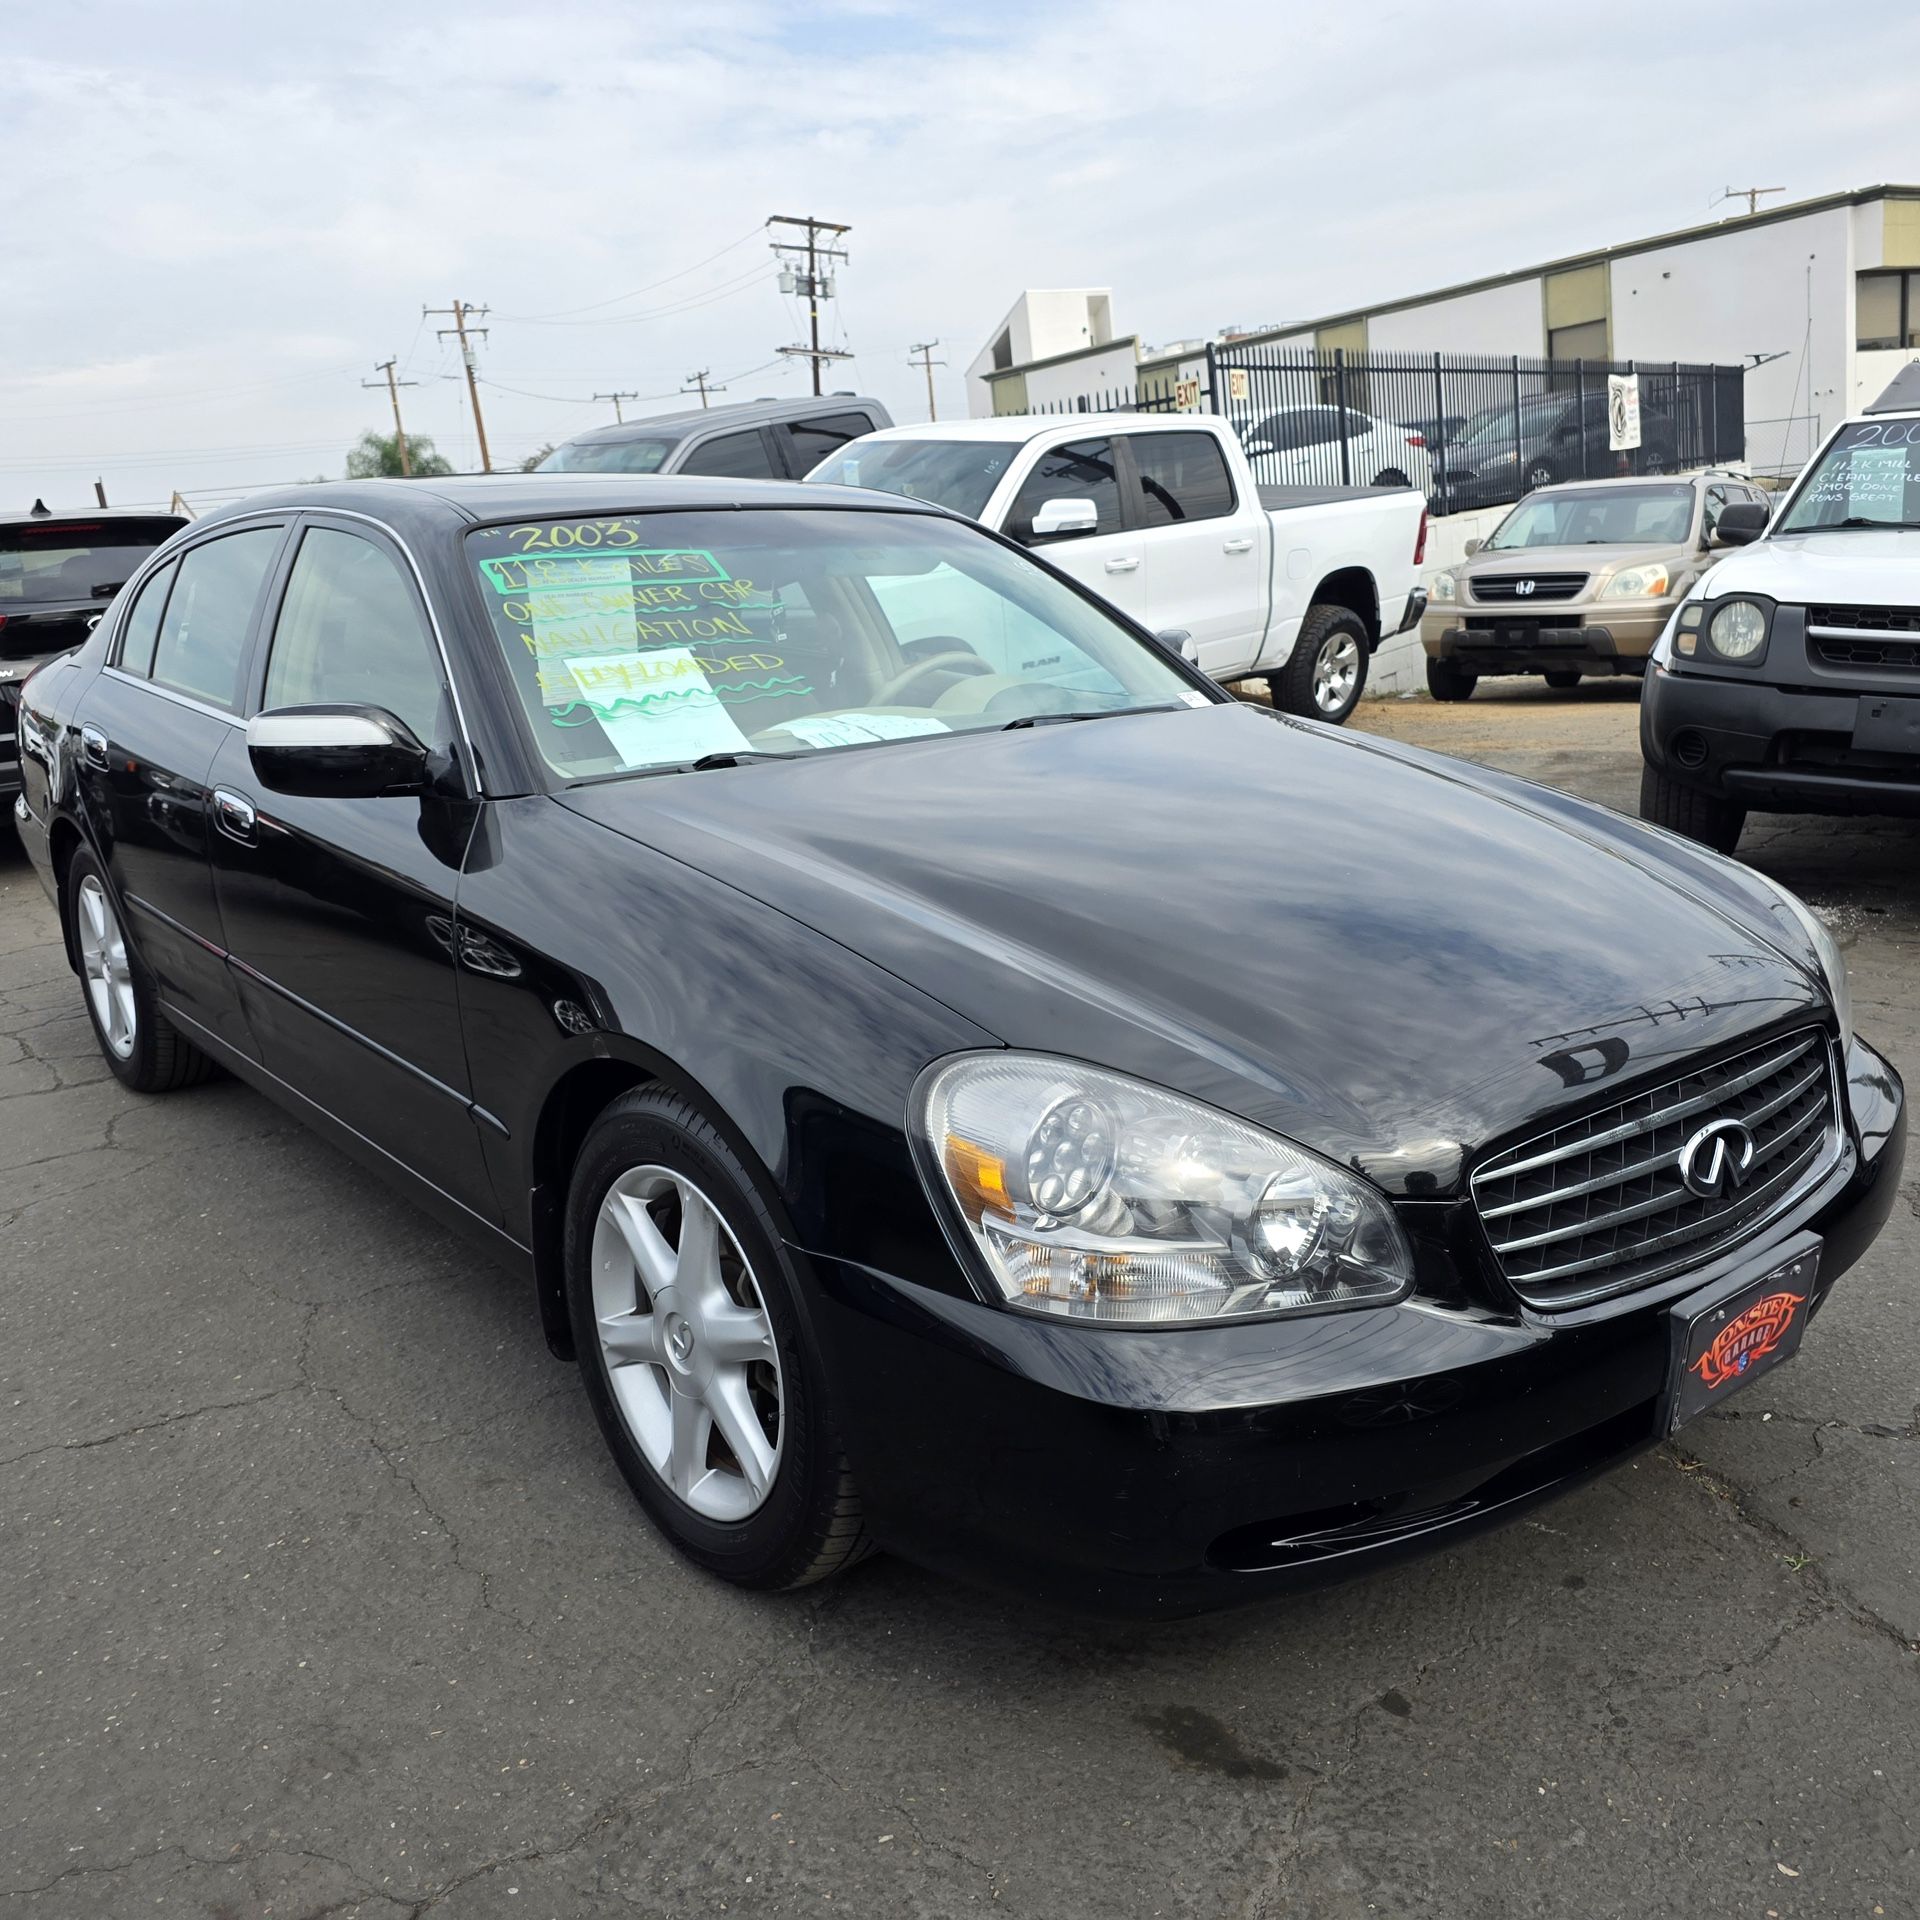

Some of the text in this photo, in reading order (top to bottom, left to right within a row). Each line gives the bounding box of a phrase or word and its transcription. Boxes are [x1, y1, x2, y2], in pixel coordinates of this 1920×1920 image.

[1176, 380, 1198, 407] EXIT
[1229, 373, 1246, 396] EXIT
[1804, 492, 1898, 504] RUNS GREAT
[1811, 482, 1901, 494] SMOG DONE
[699, 579, 757, 601] CAR
[520, 611, 753, 656] NAVIGATION
[636, 654, 784, 681] LOADED
[1022, 655, 1061, 671] RAM
[1690, 1292, 1807, 1381] MONSTER
